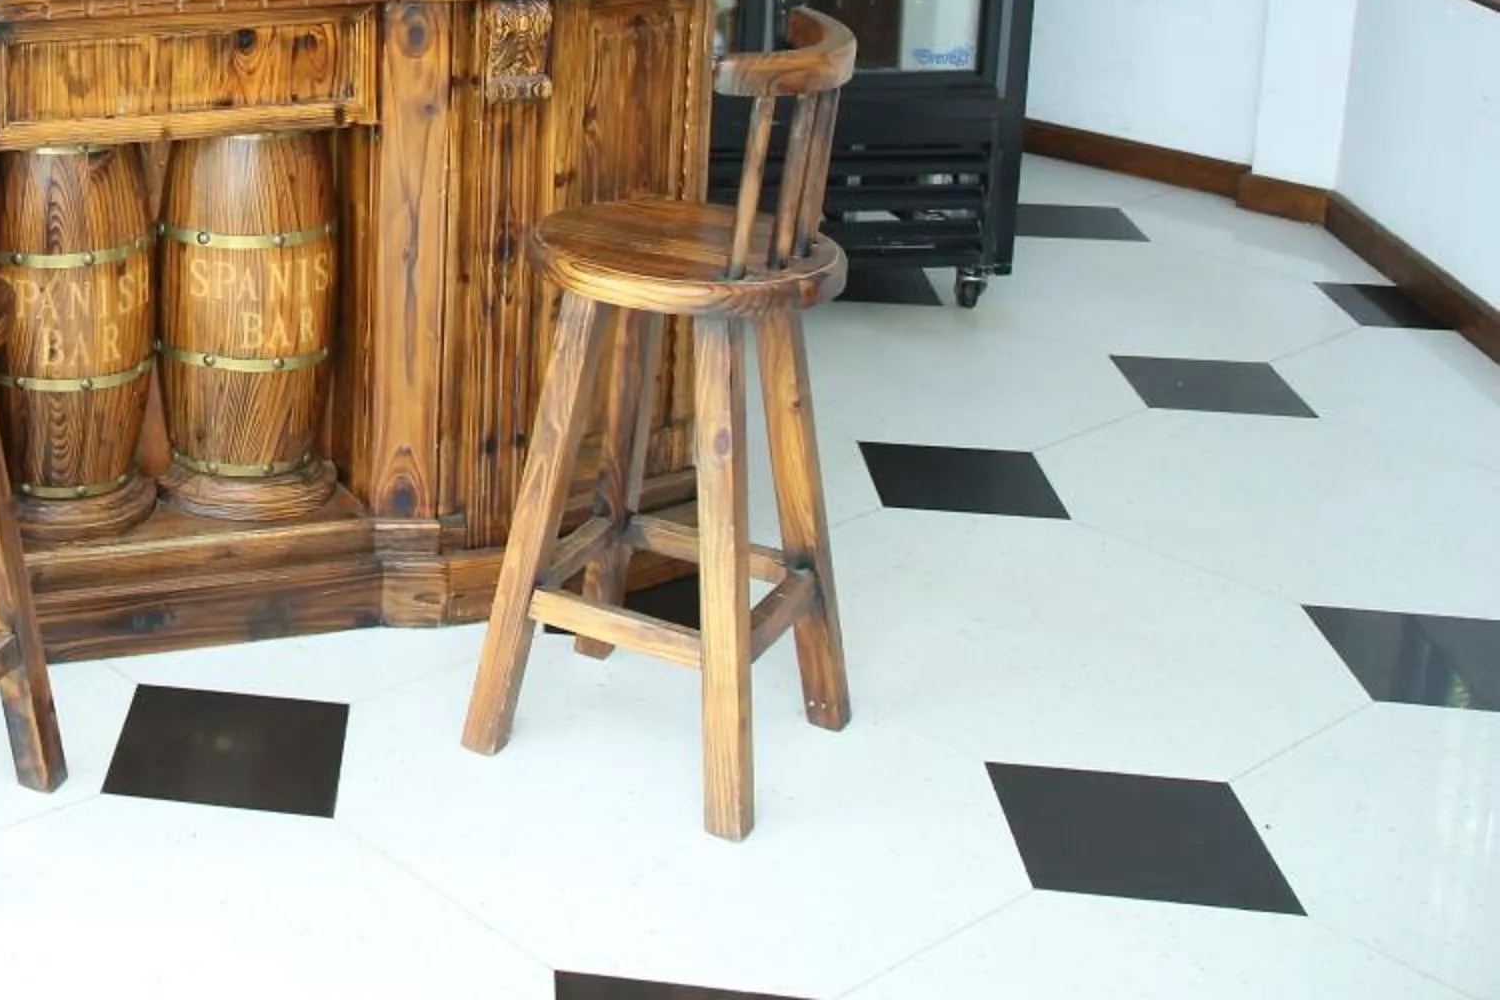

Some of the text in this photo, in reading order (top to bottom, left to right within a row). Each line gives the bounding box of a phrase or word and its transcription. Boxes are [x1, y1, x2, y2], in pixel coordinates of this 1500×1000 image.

[1, 260, 150, 321] PANISH
[188, 252, 334, 301] SPANIS
[37, 323, 122, 369] BAR
[238, 306, 317, 351] BAR
